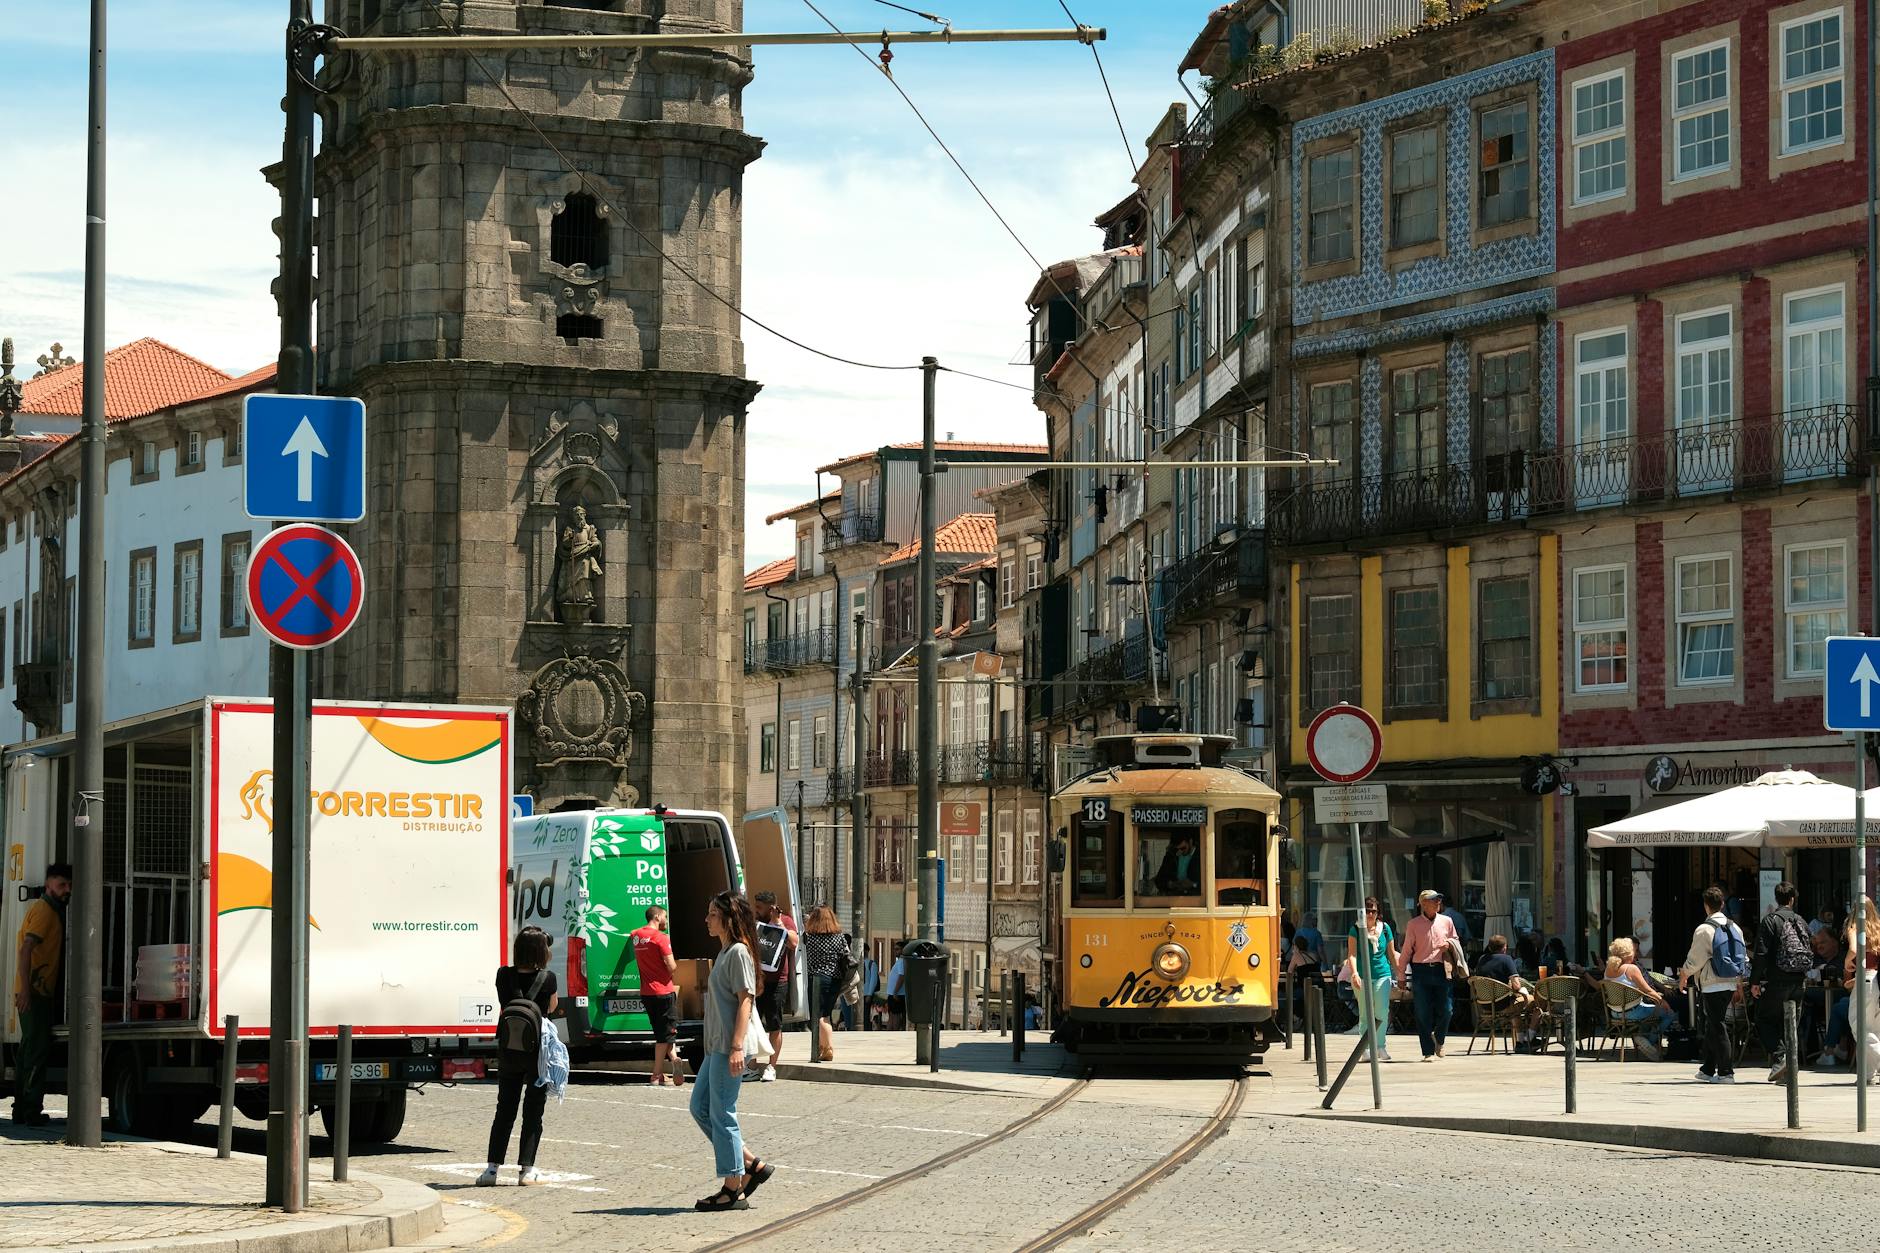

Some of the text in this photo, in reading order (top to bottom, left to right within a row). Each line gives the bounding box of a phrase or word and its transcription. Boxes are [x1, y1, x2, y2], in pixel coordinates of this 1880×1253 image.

[1679, 759, 1761, 786] Amorino
[1085, 801, 1106, 820] 18
[1135, 810, 1203, 823] PASSEIO ALEGRE
[403, 822, 482, 833] DISTRIBUIÇÃO
[552, 825, 578, 842] Zero
[1800, 822, 1816, 833] CASA
[1616, 833, 1631, 844] CASA
[1633, 833, 1671, 843] PORTUGUESA
[1673, 832, 1695, 842] PASTEL
[636, 860, 667, 880] Po
[626, 884, 652, 893] zero
[632, 896, 652, 905] nas
[372, 921, 479, 931] www.torrestir.com
[1084, 934, 1108, 946] 131
[1140, 932, 1164, 940] SINCE
[1099, 967, 1244, 1008] Niepoort
[476, 1004, 493, 1016] TP
